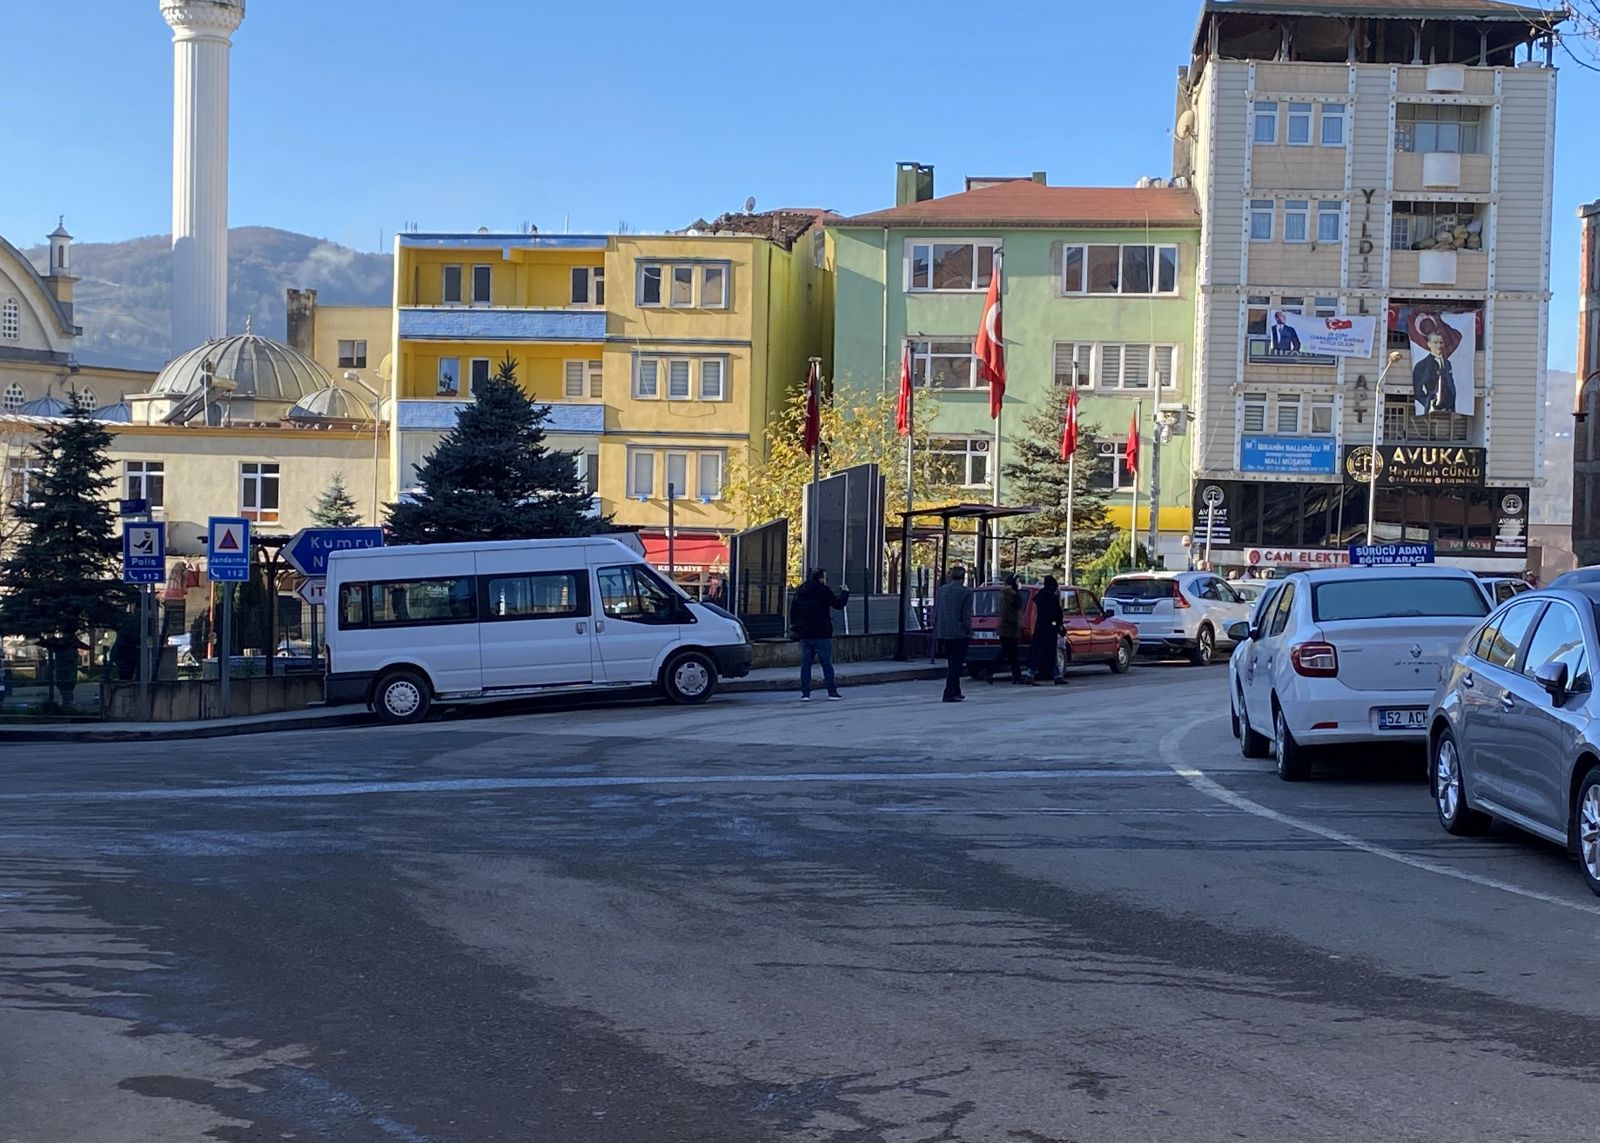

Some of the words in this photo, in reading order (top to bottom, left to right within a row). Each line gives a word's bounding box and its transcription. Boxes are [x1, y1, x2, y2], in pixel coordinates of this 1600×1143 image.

[1358, 188, 1376, 314] YILDIZL
[1391, 446, 1480, 466] AVUKAT
[311, 536, 374, 549] Kumru
[1355, 545, 1396, 556] SÜRÜCÜ
[1398, 545, 1427, 555] ADAYI
[131, 557, 157, 566] Polis
[210, 556, 247, 564] Jandarma
[1264, 550, 1293, 561] CAN
[1299, 551, 1350, 563] ELEKTR
[1359, 555, 1393, 564] EĞİTİM
[1395, 555, 1425, 563] ARACI
[143, 572, 159, 580] 112
[227, 569, 244, 577] 112
[1387, 711, 1402, 724] 52
